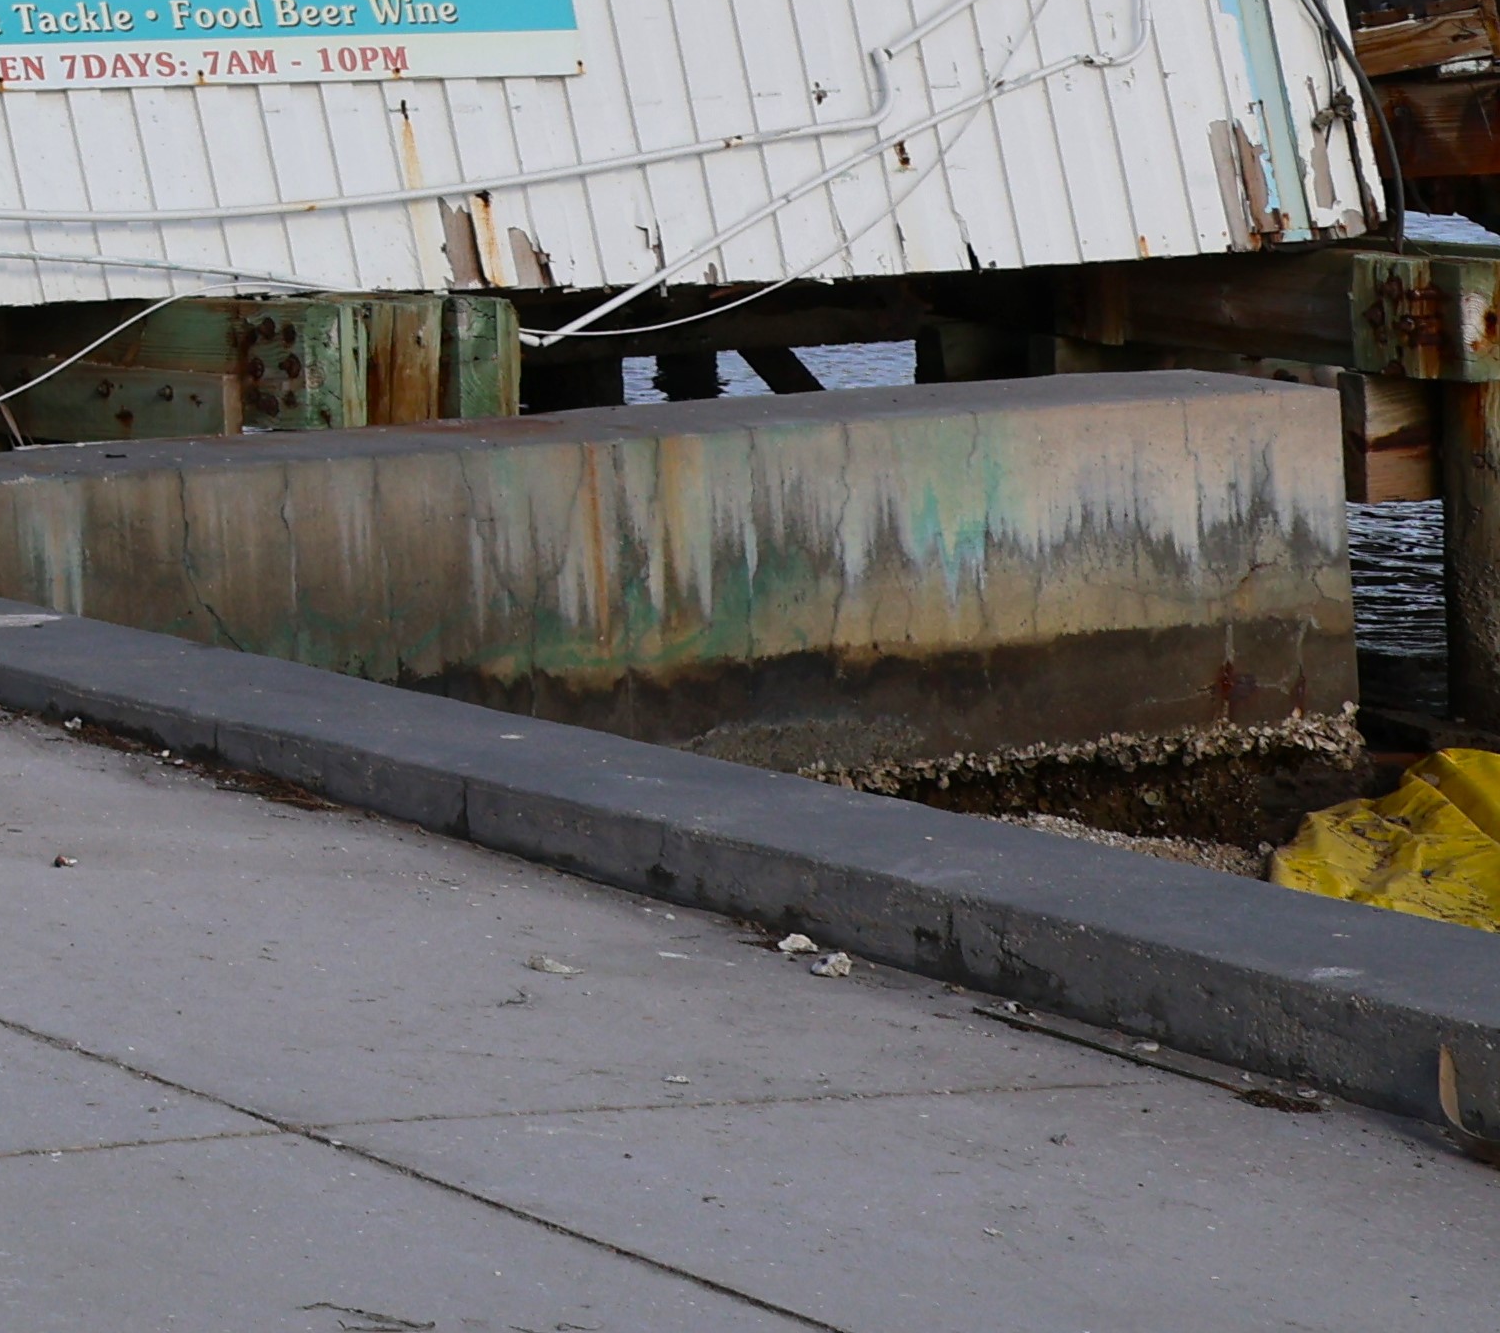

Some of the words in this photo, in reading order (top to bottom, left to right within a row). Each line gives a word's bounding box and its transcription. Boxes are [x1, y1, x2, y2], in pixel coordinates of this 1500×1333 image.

[12, 1, 135, 34] Tackle
[59, 52, 188, 80] 7DAYS:
[202, 49, 278, 76] 7AM
[316, 46, 410, 73] 10PM
